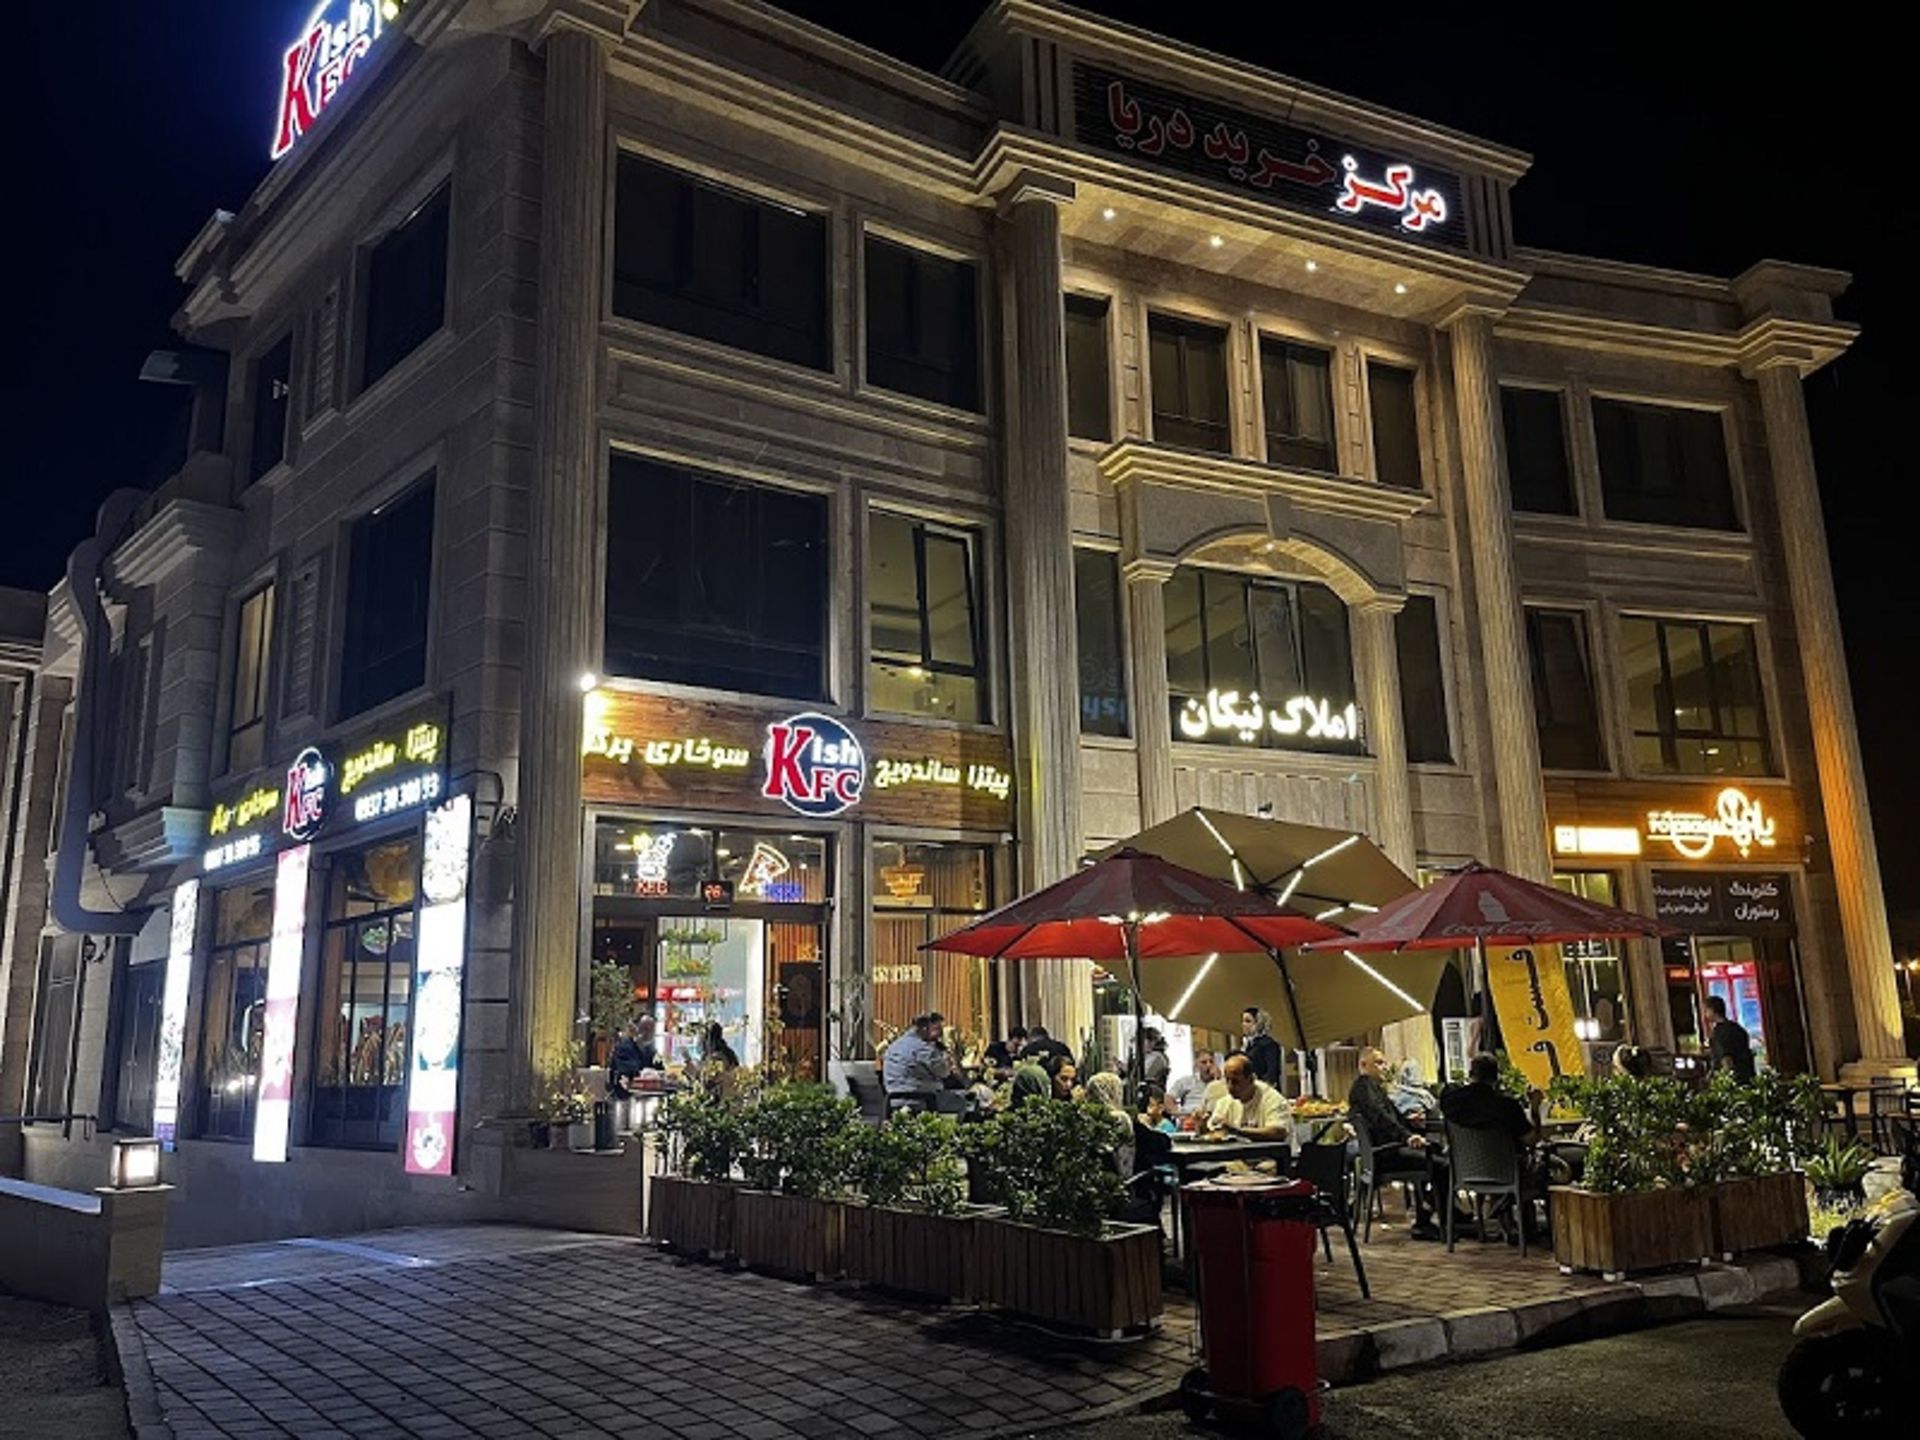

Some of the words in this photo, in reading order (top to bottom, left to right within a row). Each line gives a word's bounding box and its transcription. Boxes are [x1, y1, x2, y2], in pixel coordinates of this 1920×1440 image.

[1107, 80, 1195, 154] دریا
[1203, 122, 1337, 187] خرید
[1334, 154, 1447, 232] مرکز
[1179, 687, 1265, 742] نیکان
[1269, 694, 1358, 740] املاک
[644, 737, 750, 769] سوخاری
[873, 759, 961, 789] ساندویچ
[966, 764, 1010, 800] پیتزا
